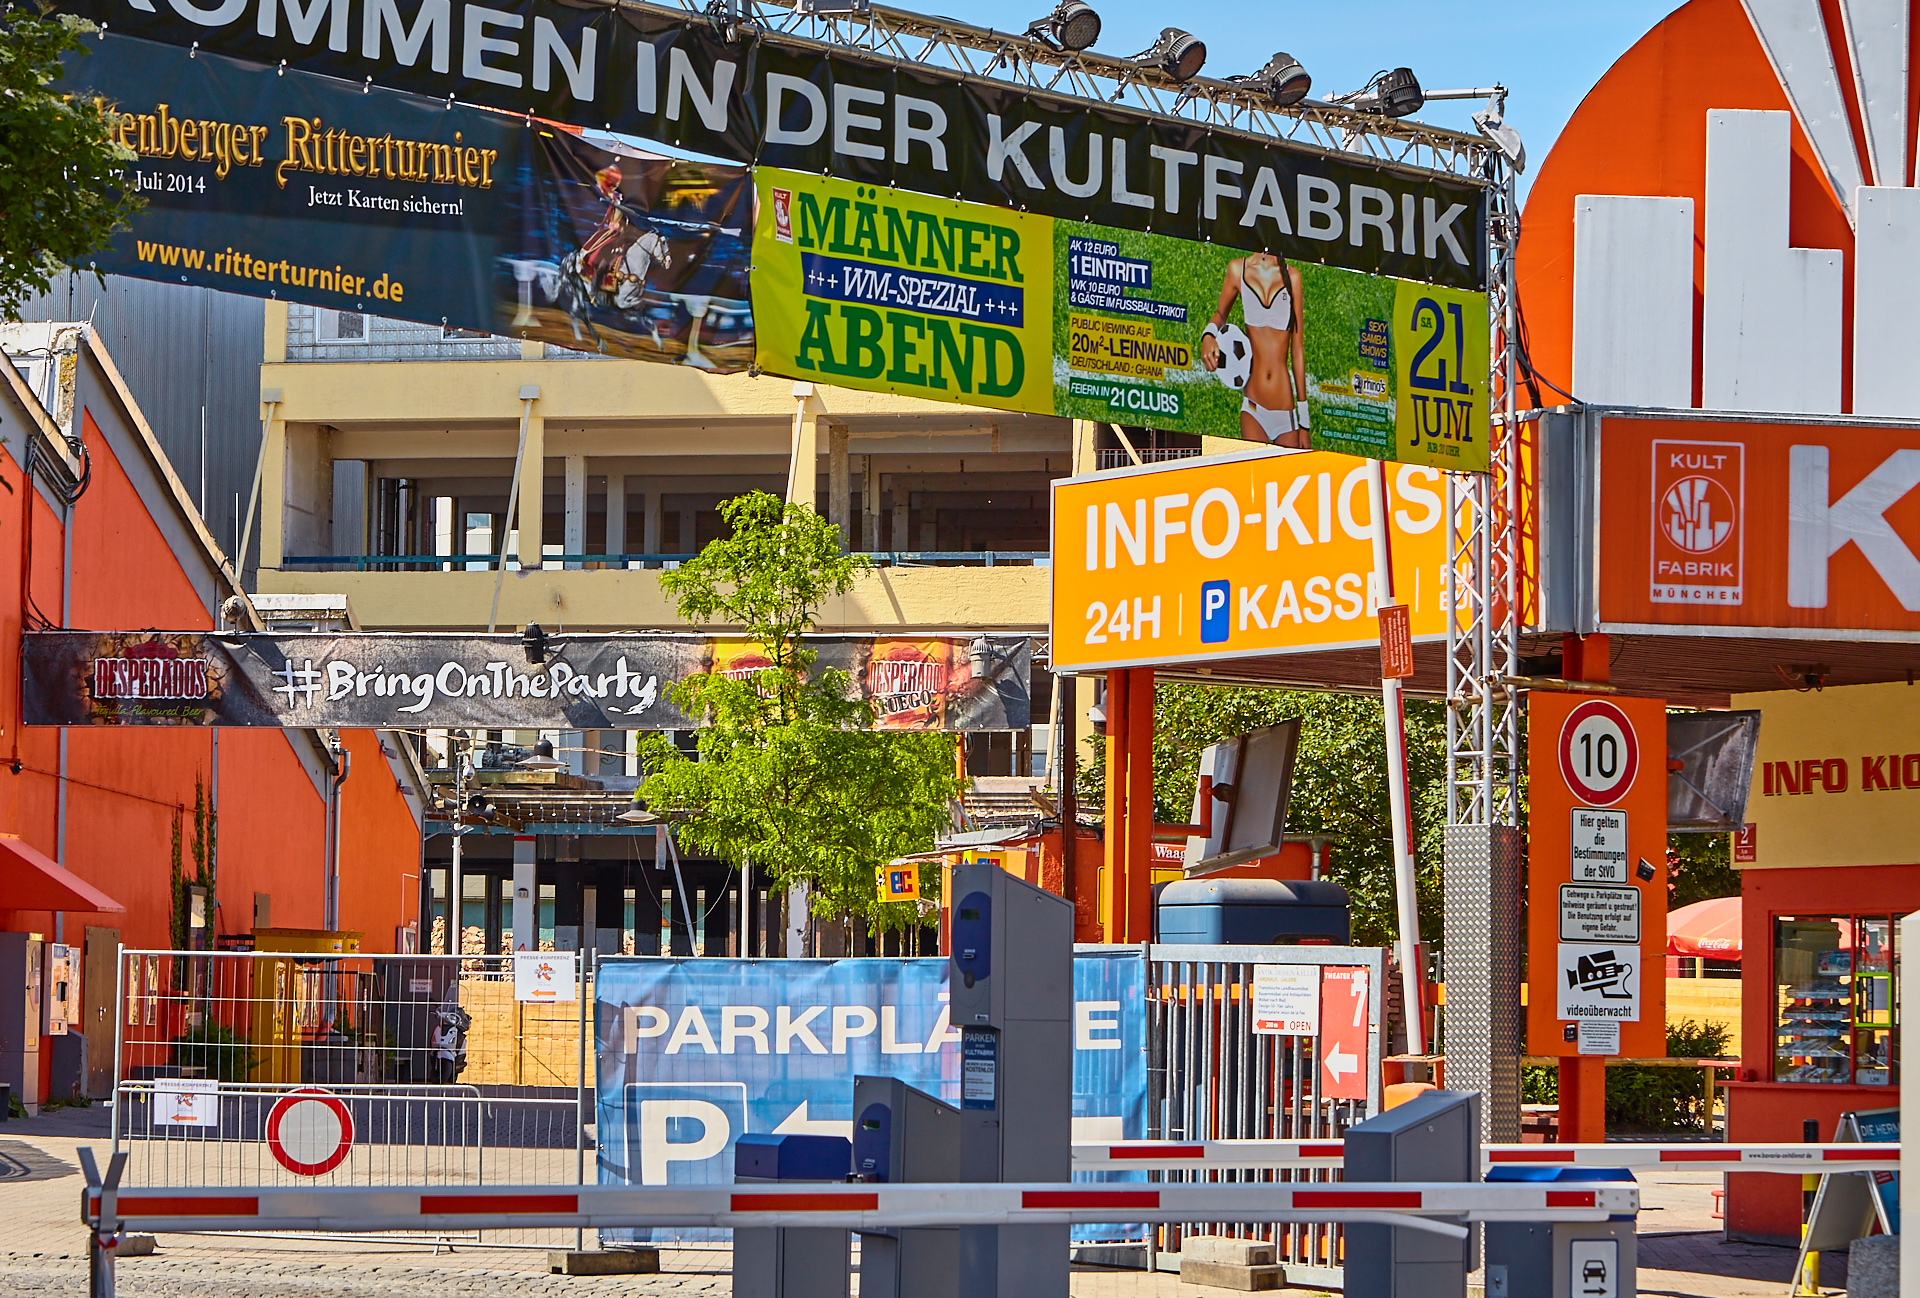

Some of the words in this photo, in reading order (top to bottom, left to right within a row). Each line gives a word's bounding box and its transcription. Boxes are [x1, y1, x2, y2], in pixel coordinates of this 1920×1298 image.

[127, 0, 597, 101] MMEN
[636, 42, 737, 132] IN
[764, 72, 949, 173] DER
[986, 113, 1470, 267] KULTFABRIK
[276, 115, 498, 189] Ritterturnier
[134, 170, 163, 192] Juli
[166, 174, 206, 194] 2014
[308, 185, 342, 207] Jetzt
[347, 189, 400, 211] Karten
[402, 194, 464, 216] sichern!
[798, 186, 1024, 283] MÄNNER
[1070, 239, 1082, 252] AK
[1083, 242, 1093, 253] 12
[1094, 243, 1118, 257] EURO
[137, 239, 404, 303] www.ritterturnier.de
[1071, 255, 1078, 275] 1
[1081, 255, 1149, 284] EINTRITT
[843, 266, 981, 316] WM-SPEZIAL
[1088, 282, 1098, 292] 10
[1098, 283, 1121, 297] EURO
[1070, 292, 1077, 303] &
[1078, 291, 1105, 307] GÄSTE
[1105, 297, 1115, 308] IM
[1115, 299, 1186, 319] FUSSBALL-TRIKOT
[1071, 317, 1101, 332] PUBLIC
[1102, 321, 1136, 336] VIEWING
[1136, 326, 1152, 338] AUF
[1368, 321, 1388, 333] SEXY
[1420, 316, 1433, 329] SA
[1361, 332, 1387, 346] SAMBA
[1410, 297, 1474, 396] 21.
[794, 299, 1025, 399] ABEND
[1361, 344, 1387, 358] SHOWS
[1071, 356, 1130, 374] DEUTSCHLAND
[1135, 363, 1163, 377] GHANA
[1070, 382, 1100, 397] FEIERN
[1101, 386, 1110, 398] IN
[1110, 387, 1125, 408] 21
[1127, 388, 1179, 415] CLUBS
[1410, 394, 1473, 446] JUNI
[1322, 430, 1333, 438] KEIN
[1427, 442, 1438, 454] AB
[1445, 445, 1460, 457] UHR
[1670, 453, 1728, 469] KULT
[1086, 463, 1497, 571] INFO-KIOS
[1787, 444, 1920, 612] K
[1658, 561, 1734, 577] FABRIK
[1653, 588, 1740, 600] MÜNCHEN
[1085, 595, 1161, 645] 24H
[1205, 589, 1225, 620] P
[95, 659, 207, 698] DESPERADOS
[272, 656, 657, 715] #BringOnTheParty
[96, 705, 127, 718] Tequila
[181, 705, 204, 716] Beer
[1580, 733, 1618, 778] 10
[1763, 758, 1848, 796] INFO
[1580, 814, 1595, 828] Hier
[1596, 815, 1619, 831] gelten
[1594, 832, 1605, 846] die
[1741, 827, 1749, 844] 2
[1574, 846, 1626, 864] Bestimmungen
[1584, 864, 1596, 878] der
[1598, 865, 1615, 879] StVO
[1566, 889, 1590, 901] Gehwege
[1596, 890, 1622, 901] Parkplätze
[1562, 901, 1585, 909] teilweise
[1586, 901, 1608, 912] geräumt
[1613, 903, 1638, 912] gestreut!
[1567, 911, 1576, 919] Die
[1577, 911, 1603, 922] Benutzung
[1604, 912, 1622, 923] erfolgt
[1623, 913, 1632, 921] auf
[1581, 922, 1599, 933] eigene
[1599, 923, 1618, 932] Gefahr.
[1324, 971, 1350, 979] THEATER
[1566, 1004, 1632, 1017] videoüberwacht
[1289, 1021, 1311, 1030] OPEN
[965, 1033, 996, 1043] PARKEN
[966, 1066, 994, 1074] KOSTENLOS
[1860, 1124, 1875, 1137] DIE
